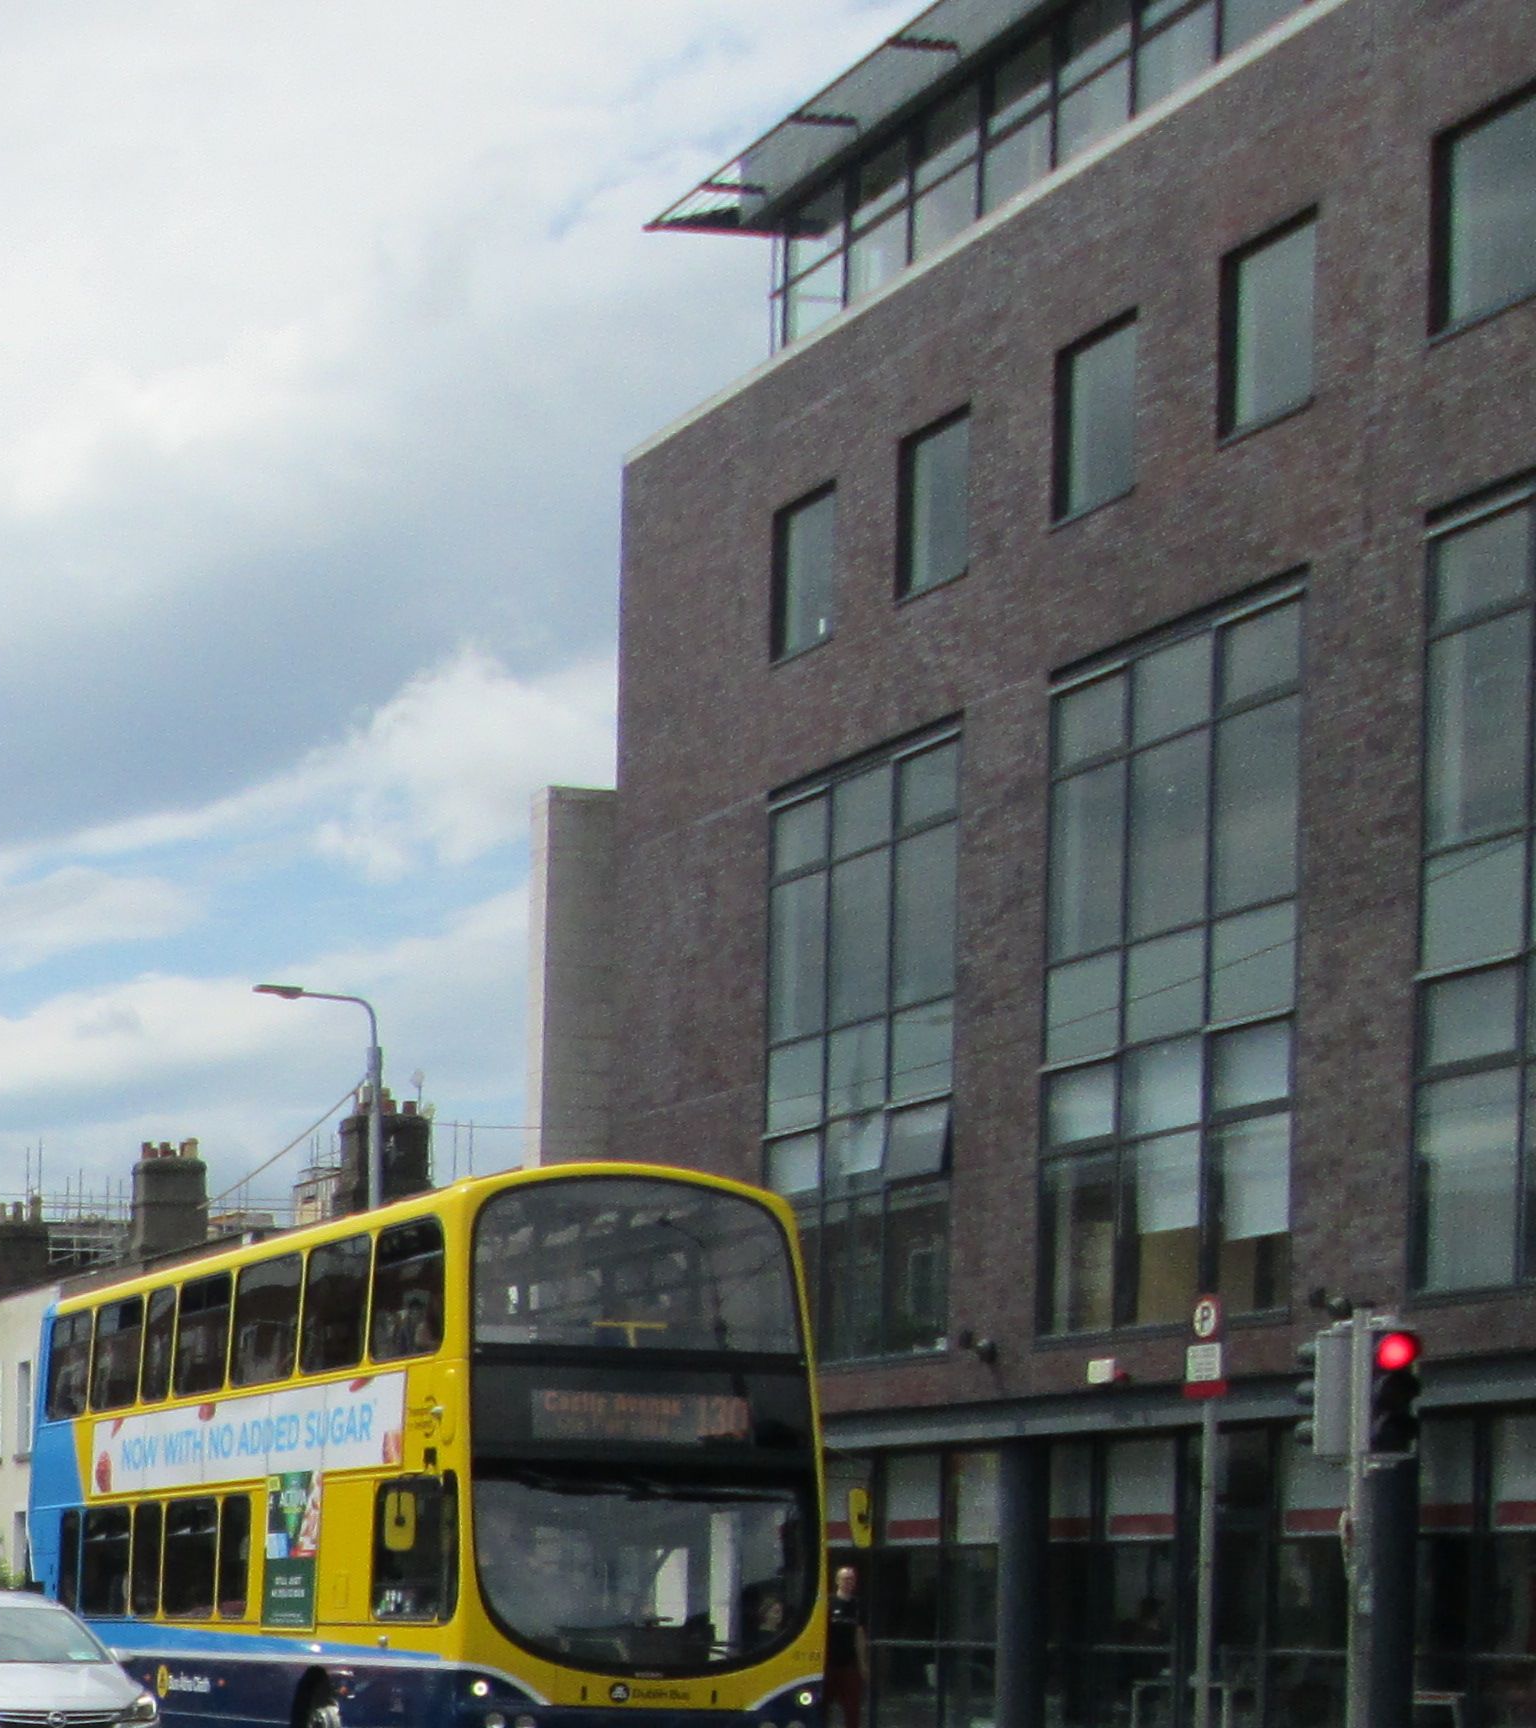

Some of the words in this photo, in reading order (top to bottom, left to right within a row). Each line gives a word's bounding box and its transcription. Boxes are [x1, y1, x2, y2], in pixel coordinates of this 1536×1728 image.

[121, 1437, 157, 1471] NOW
[164, 1429, 203, 1467] WITH
[209, 1424, 234, 1459] NO
[239, 1414, 300, 1456] ADDED
[305, 1403, 373, 1449] SUGAR
